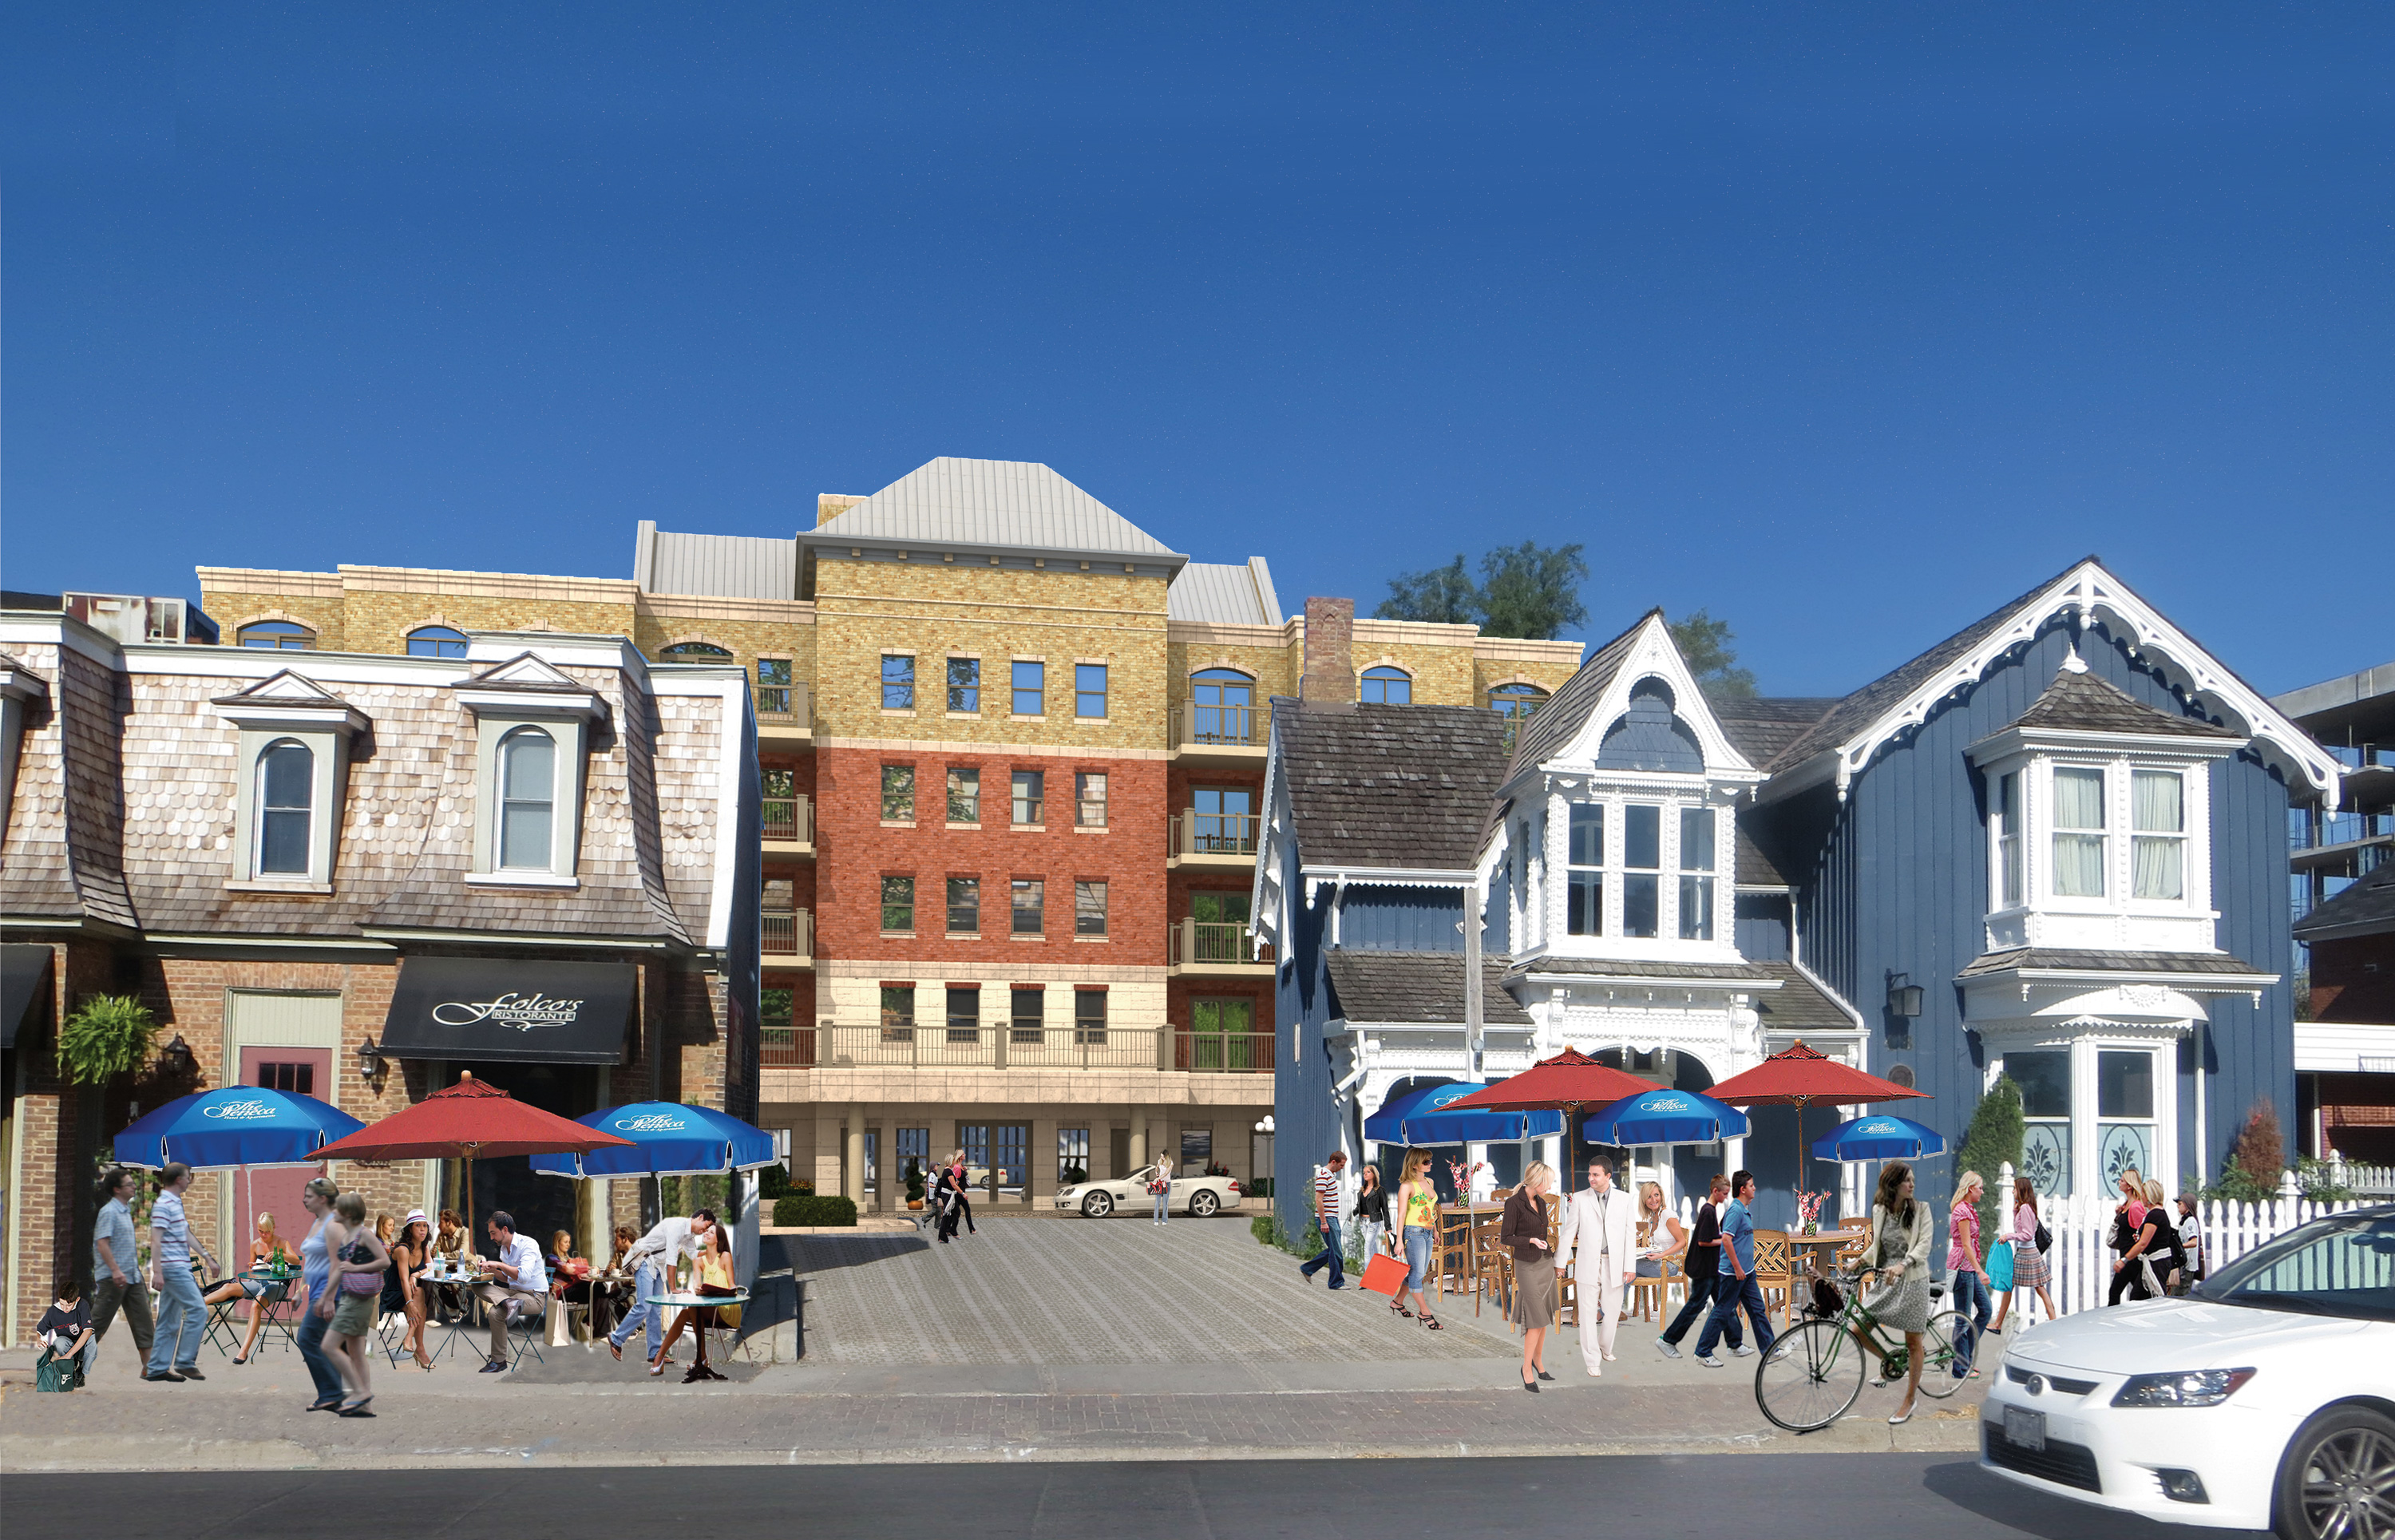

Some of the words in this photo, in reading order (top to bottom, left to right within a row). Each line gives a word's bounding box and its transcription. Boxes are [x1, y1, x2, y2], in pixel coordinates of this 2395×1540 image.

[432, 992, 584, 1025] Folco's
[493, 1011, 575, 1020] RISTORANTE
[204, 1102, 276, 1118] Seneca
[228, 1100, 263, 1110] The
[615, 1115, 686, 1130] Seneca
[639, 1114, 673, 1123] The
